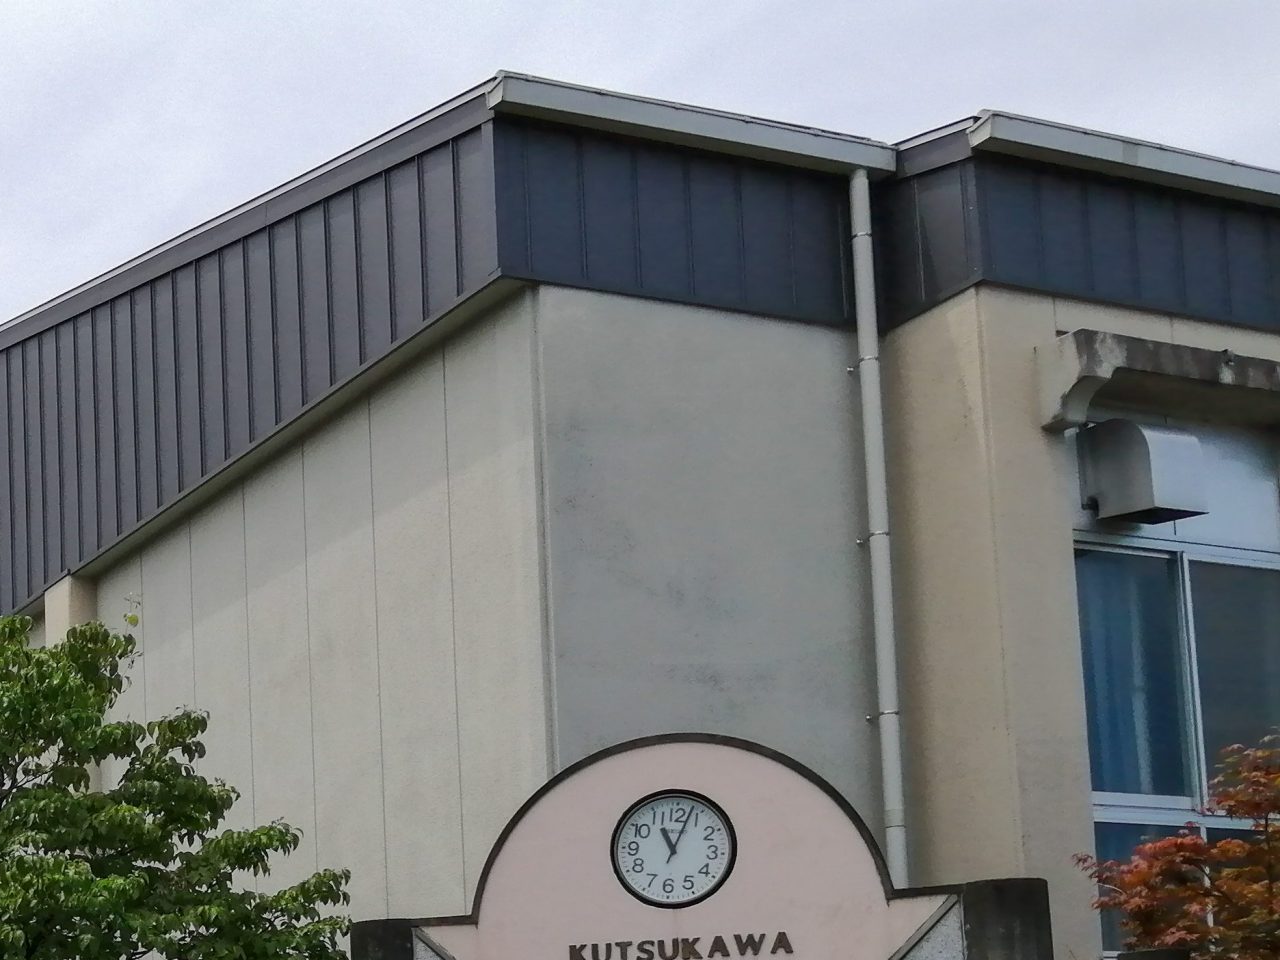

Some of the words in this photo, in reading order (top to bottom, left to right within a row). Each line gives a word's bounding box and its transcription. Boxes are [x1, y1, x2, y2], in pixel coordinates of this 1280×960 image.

[652, 810, 665, 826] 11
[669, 807, 687, 823] 12
[634, 823, 651, 839] 10
[703, 825, 715, 841] 2
[627, 841, 640, 856] 9
[706, 844, 718, 860] 3
[631, 858, 644, 873] 8
[697, 863, 711, 878] 4
[646, 873, 658, 888] 7
[662, 878, 675, 894] 6
[682, 875, 695, 890] 5
